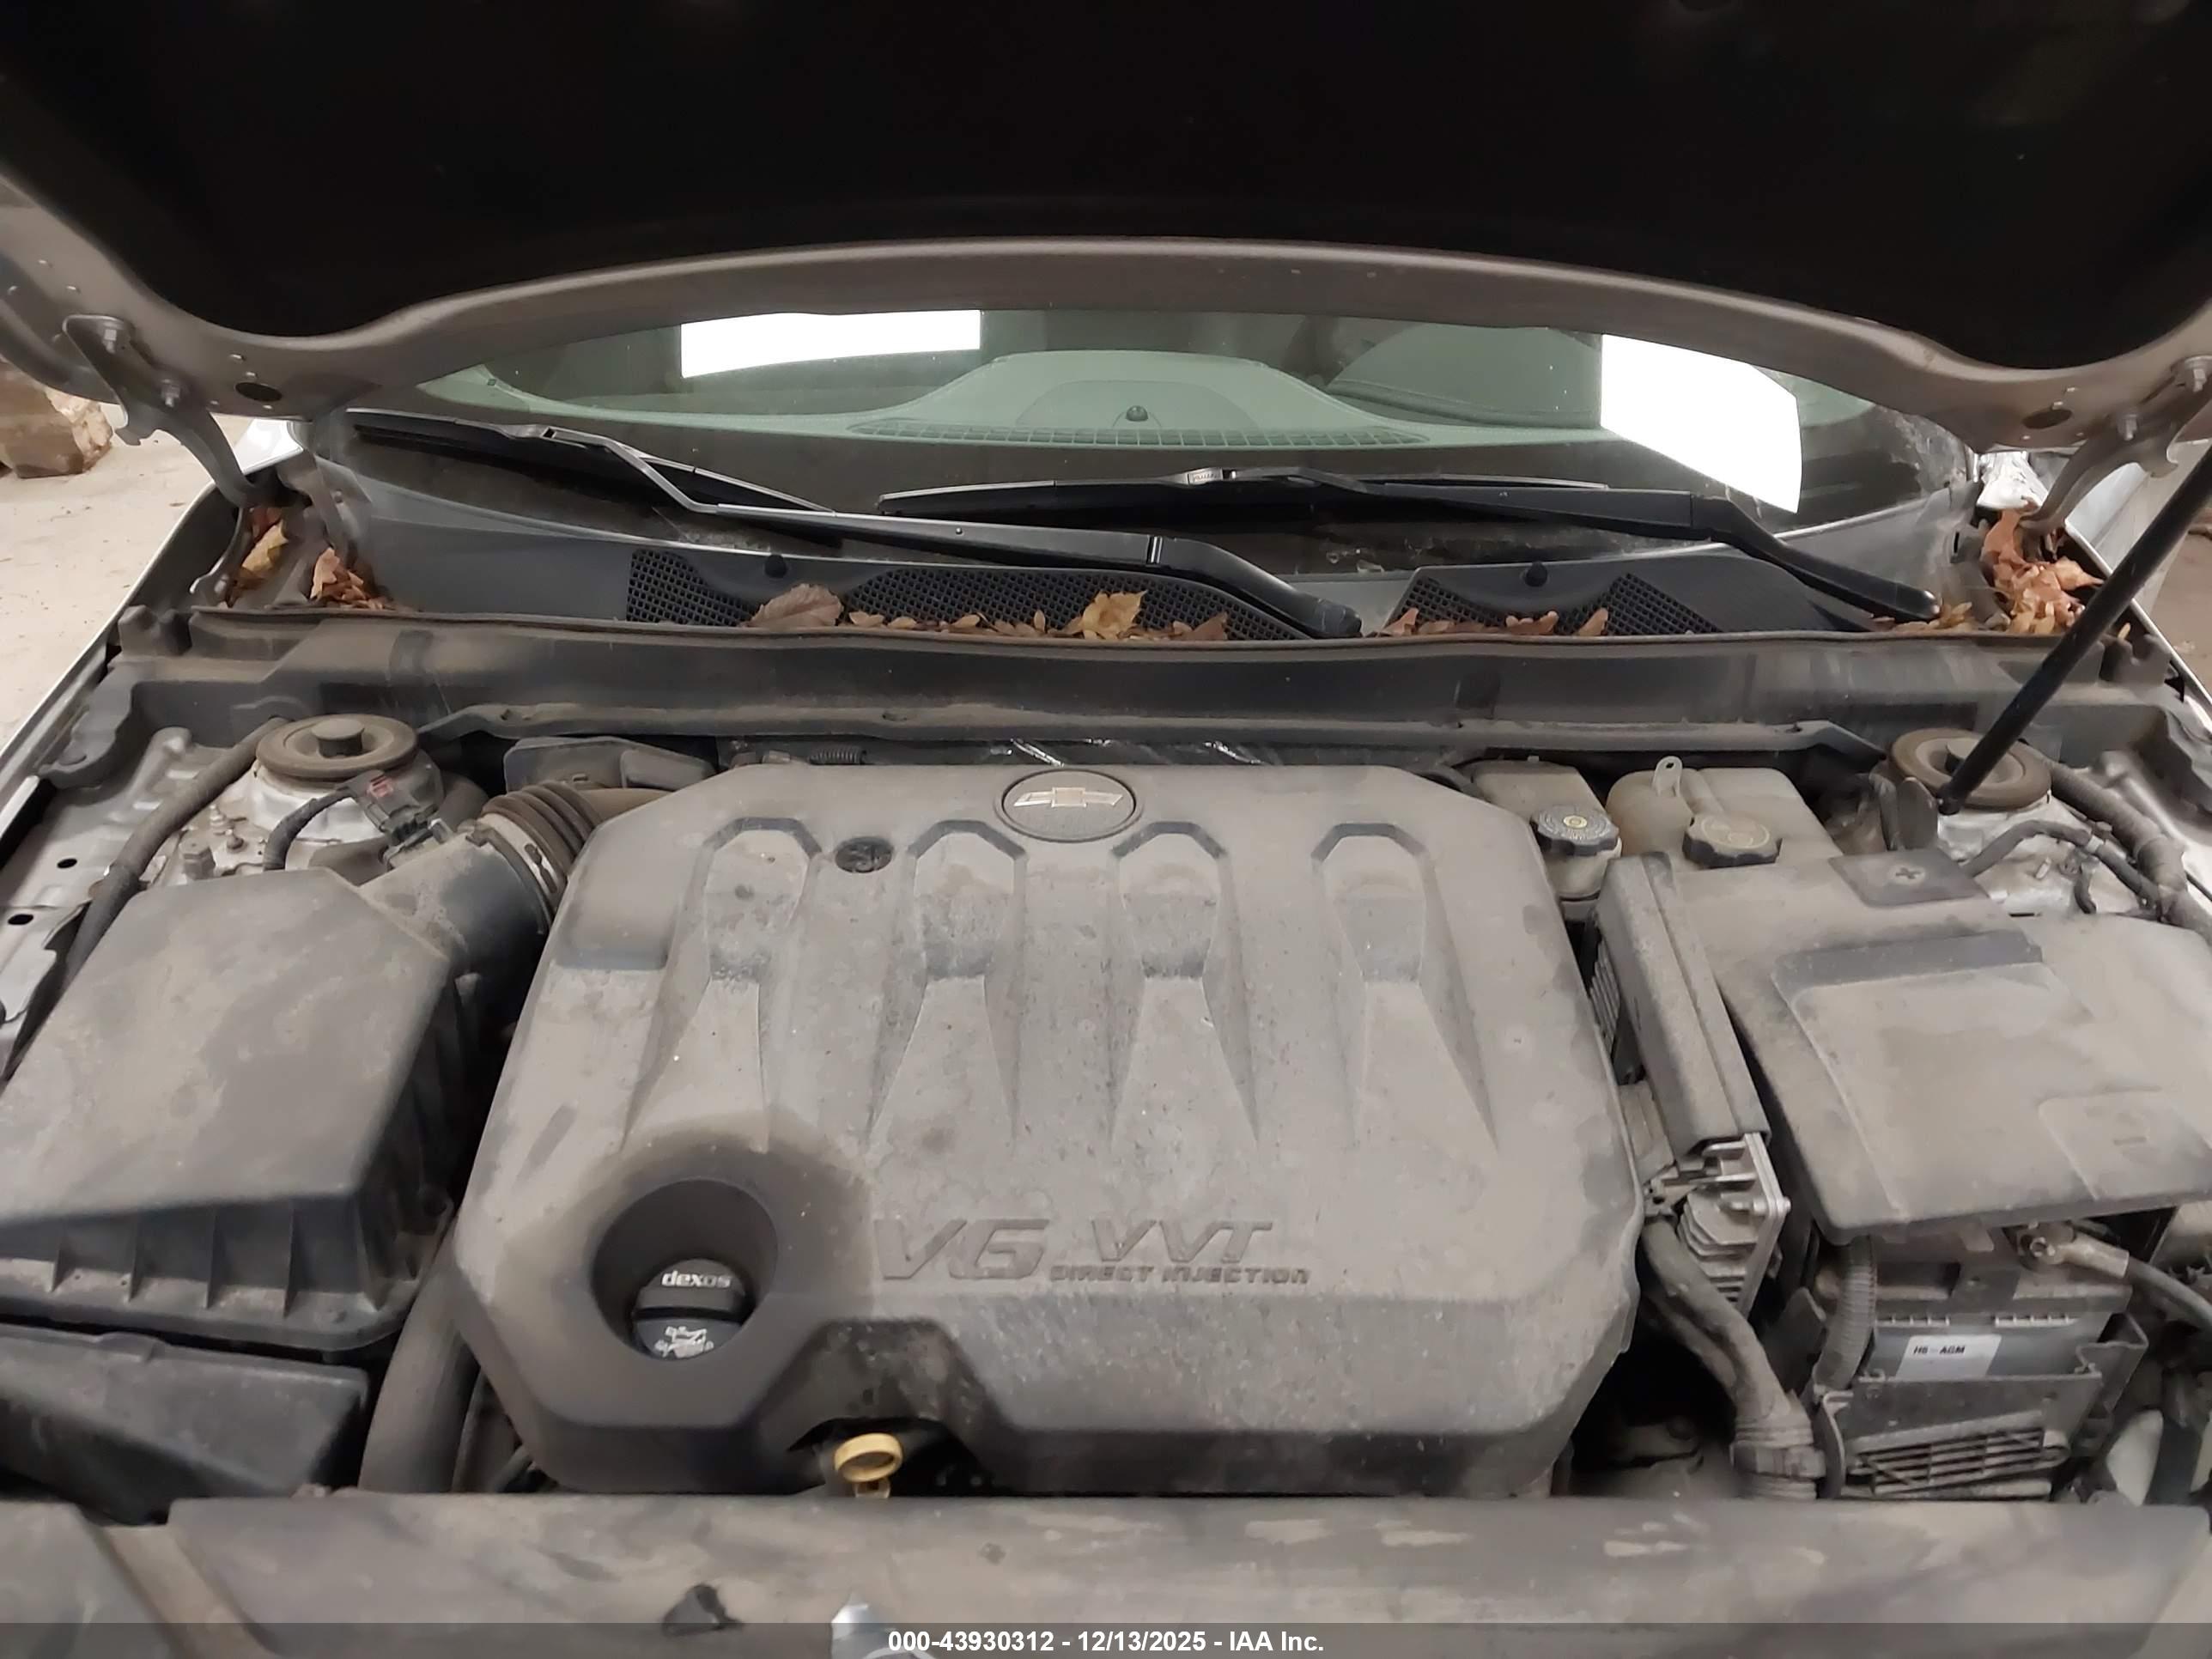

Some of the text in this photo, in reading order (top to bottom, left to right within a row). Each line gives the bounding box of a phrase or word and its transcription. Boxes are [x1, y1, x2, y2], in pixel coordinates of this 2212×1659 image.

[874, 1218, 1273, 1279] V6 VVT
[661, 1270, 731, 1288] dexos
[1049, 1265, 1310, 1285] DIRECT INJECTION
[1940, 1346, 1965, 1354] AGM
